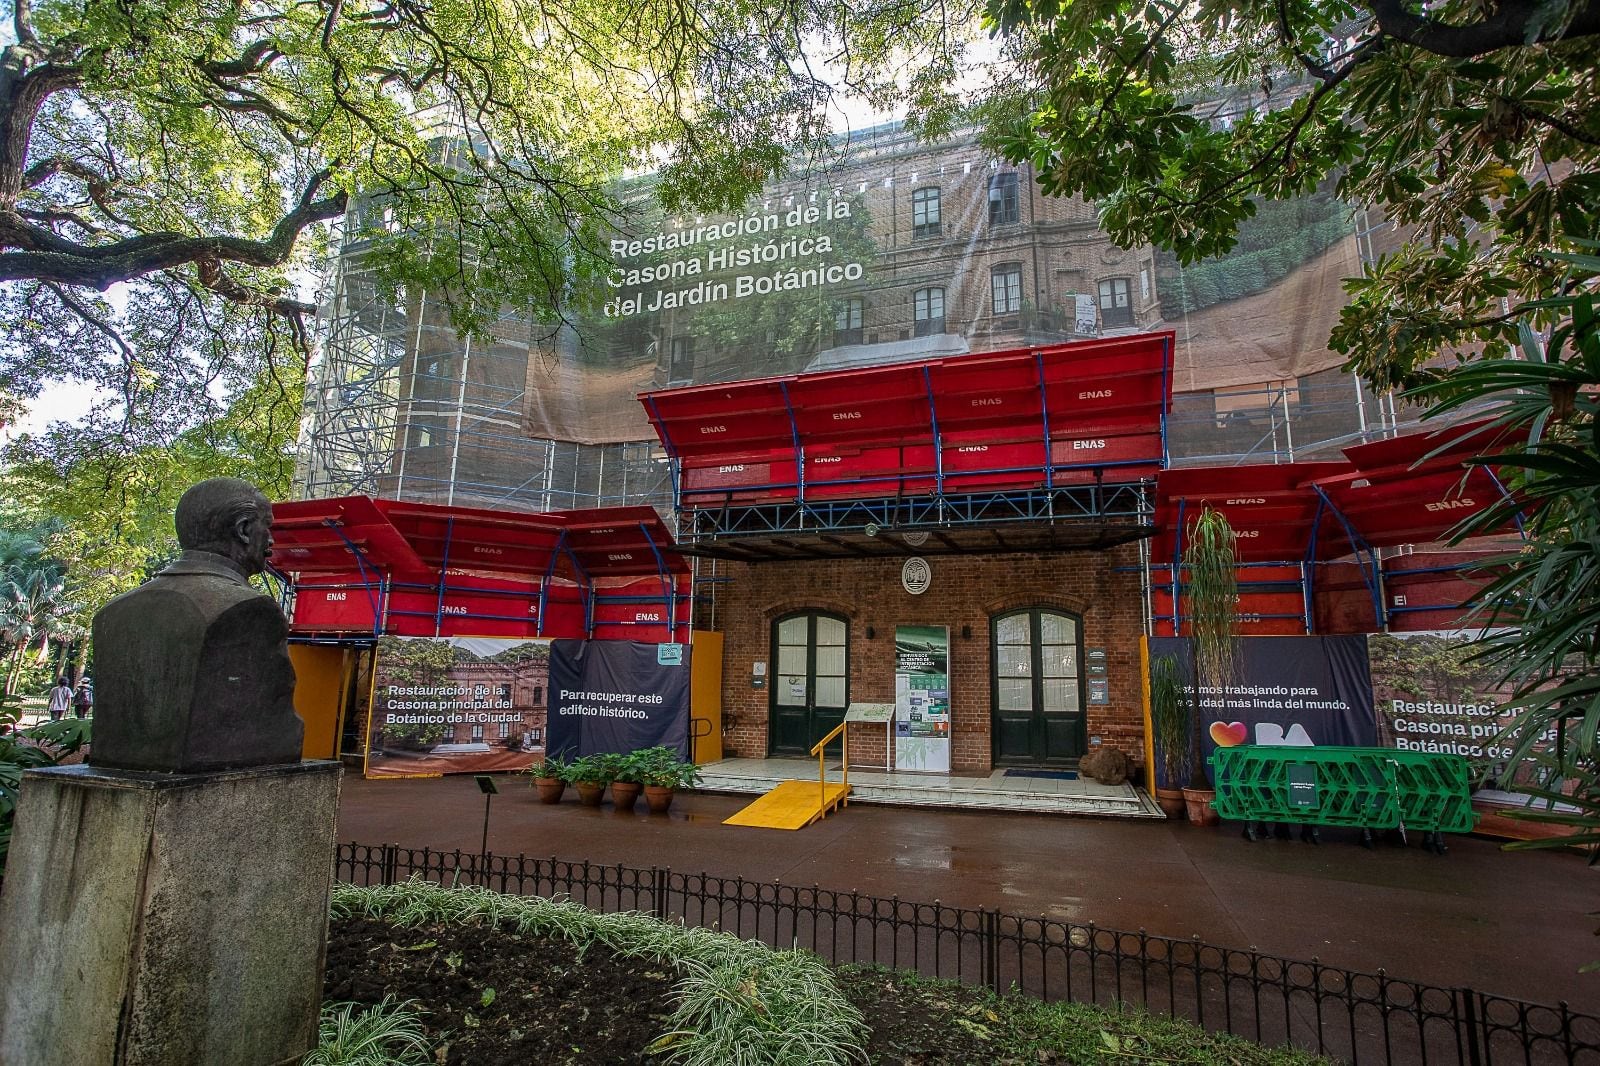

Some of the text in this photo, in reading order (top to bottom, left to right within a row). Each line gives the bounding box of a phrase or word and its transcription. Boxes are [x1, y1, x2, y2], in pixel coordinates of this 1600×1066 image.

[610, 199, 851, 259] Restauración de la
[607, 235, 832, 288] Casona Histórica
[603, 262, 863, 317] del Jardín Botánico
[1079, 389, 1112, 400] ENAS
[971, 397, 1003, 407] ENAS
[832, 411, 862, 420] ENAS
[700, 425, 727, 434] ENAS
[1073, 439, 1106, 450] ENAS
[719, 464, 744, 474] ENAS
[1424, 498, 1476, 512] ENAS
[473, 546, 503, 555] ENAS
[608, 553, 633, 561] ENAS
[326, 593, 347, 601] ENAS
[635, 613, 659, 621] ENAS
[388, 685, 504, 697] Restauración de la
[560, 689, 663, 704] Para recuperar este
[1225, 685, 1288, 697] trabajando
[1291, 687, 1319, 696] para
[387, 699, 513, 711] Casona principal del
[1227, 699, 1252, 708] más
[1253, 699, 1282, 709] linda
[1284, 699, 1303, 709] del
[1306, 699, 1350, 710] mundo.
[386, 711, 524, 724] Botánico de la Ciudad.
[599, 705, 649, 719] histórico.
[1394, 719, 1467, 736] Casona
[1396, 737, 1513, 759] Botánico de
